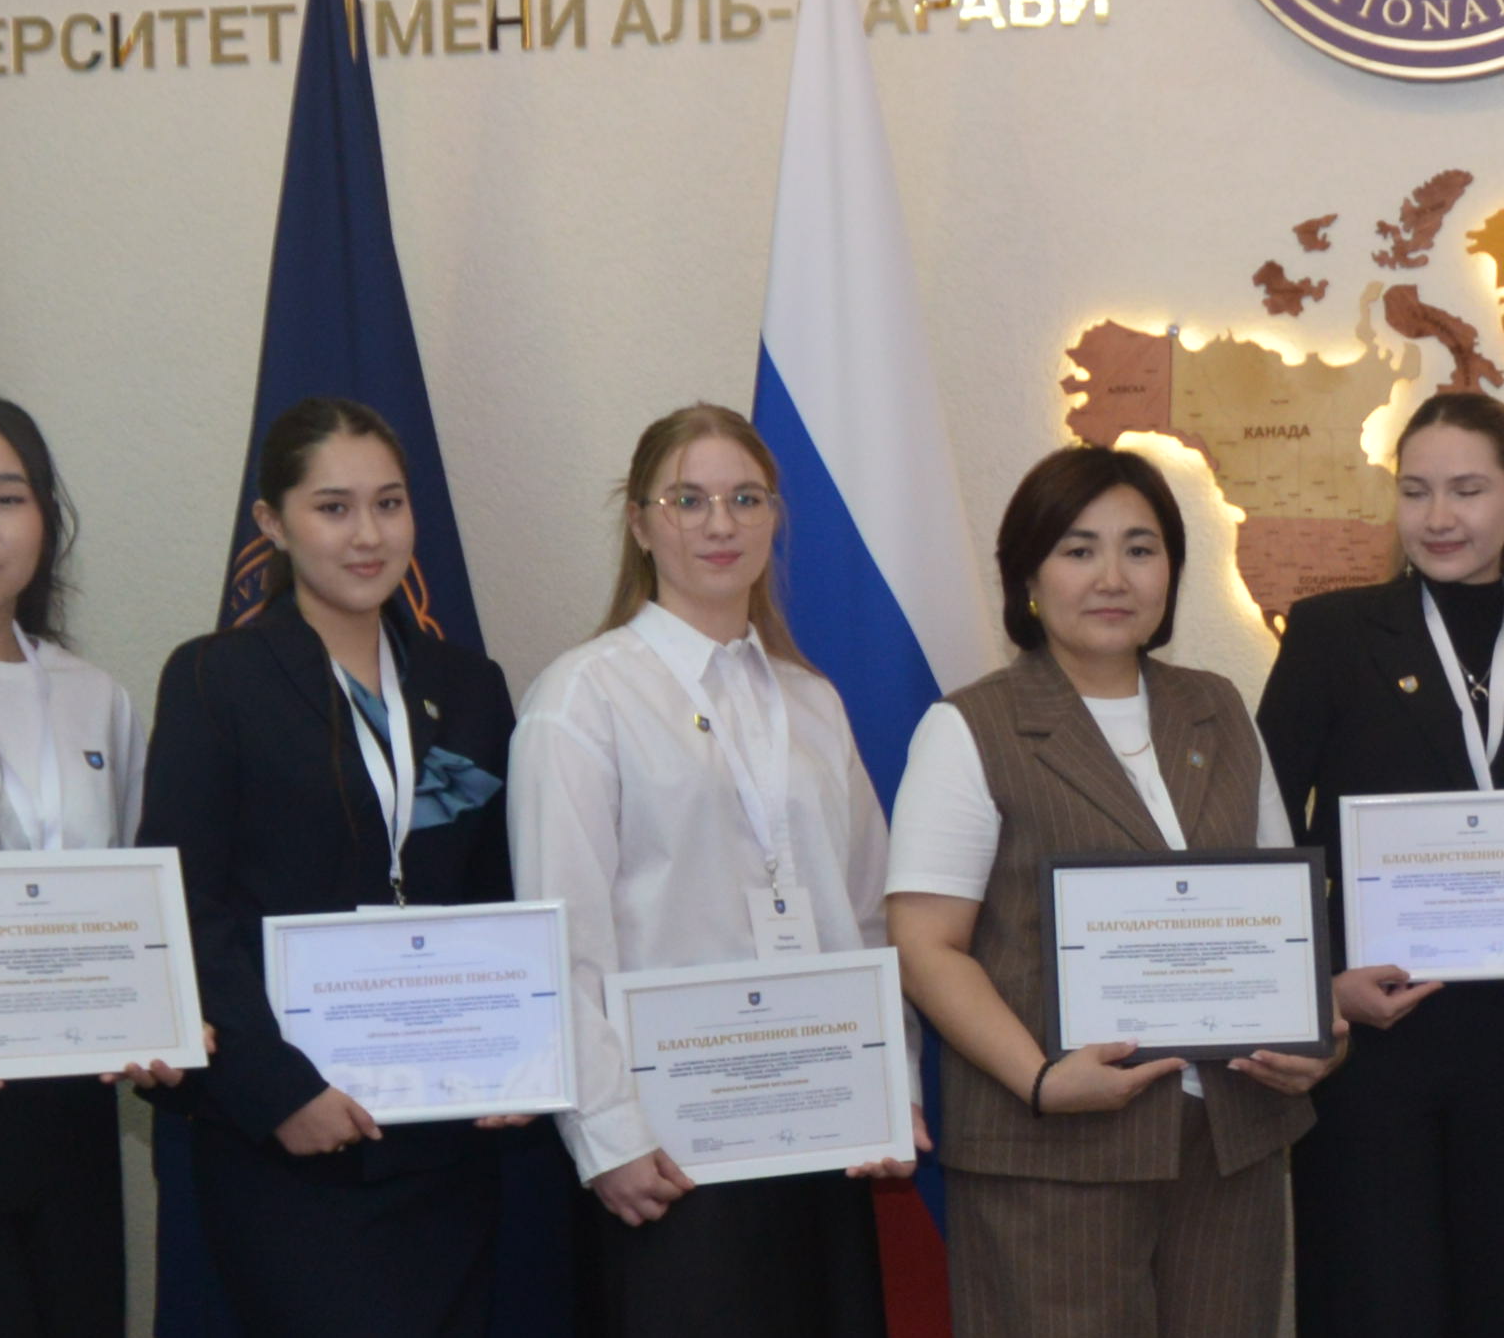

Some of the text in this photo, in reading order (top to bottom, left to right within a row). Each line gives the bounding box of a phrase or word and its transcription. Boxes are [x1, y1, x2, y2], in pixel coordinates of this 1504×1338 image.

[1243, 424, 1311, 441] КАНАДА
[656, 1021, 858, 1053] БЛАГОДАРСТВЕННОЕ ПИСЬМО
